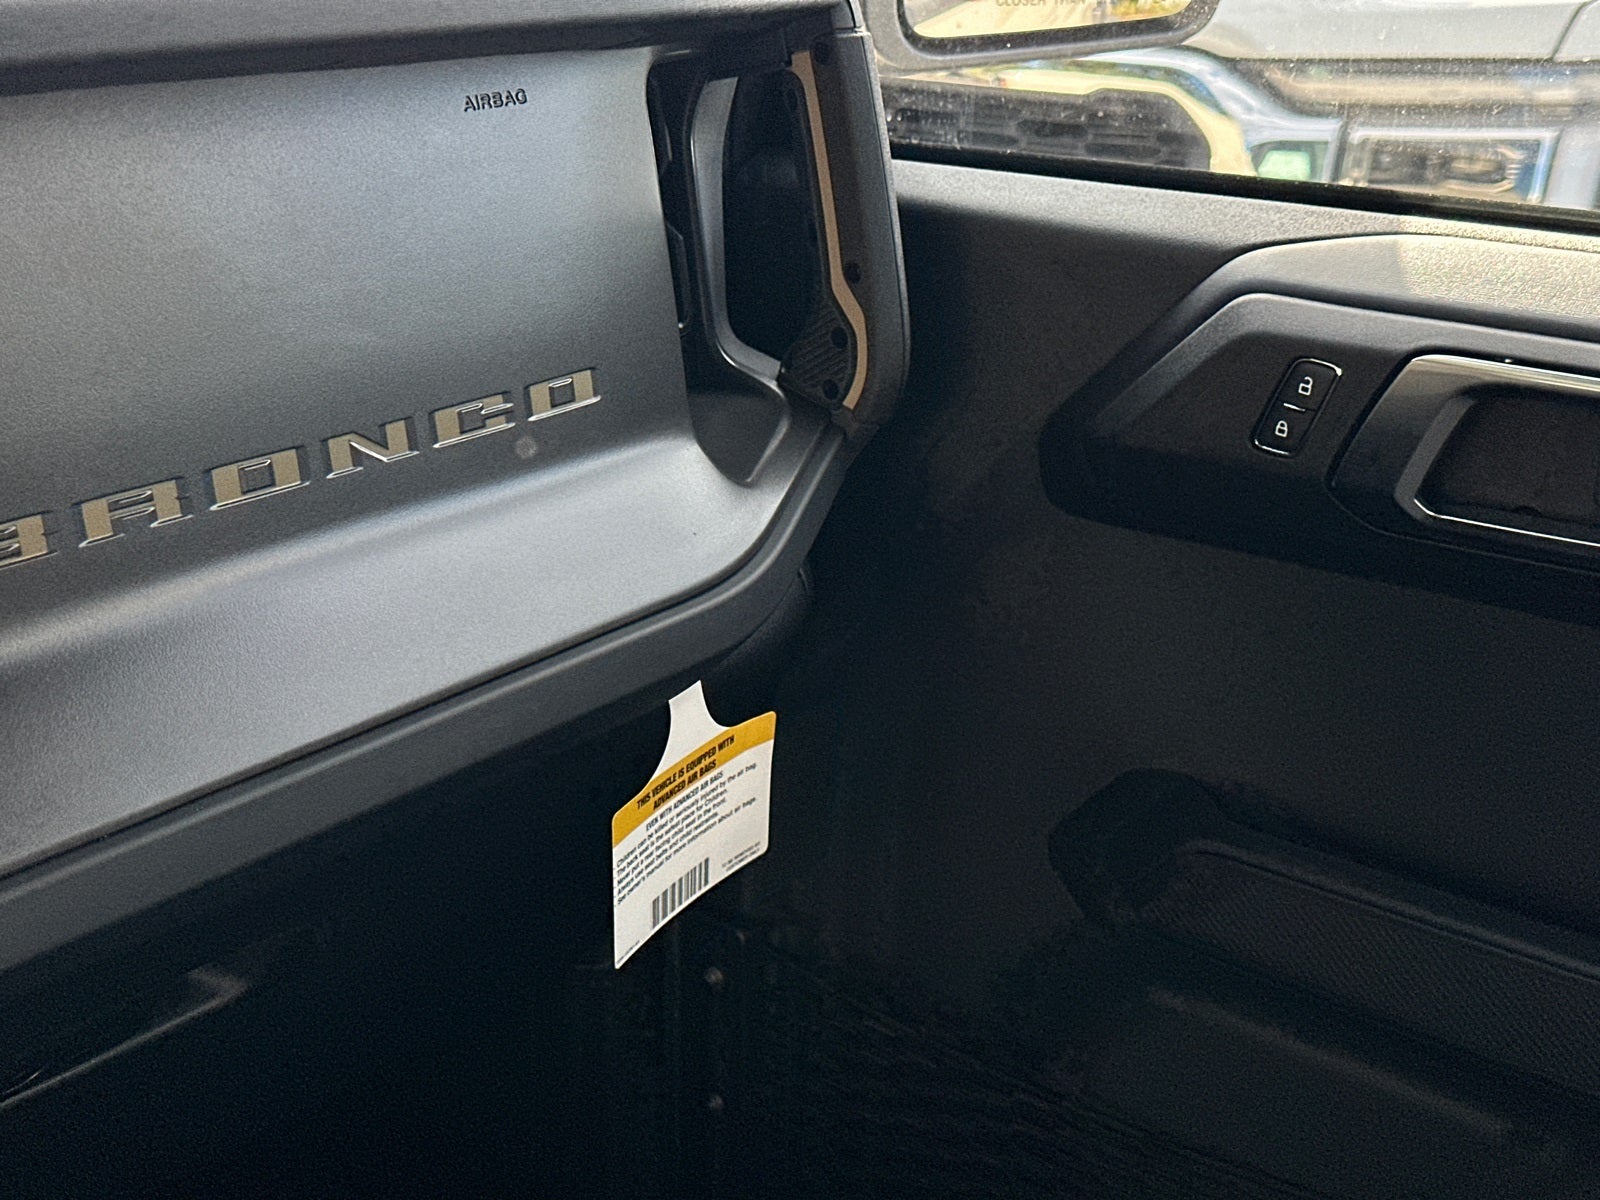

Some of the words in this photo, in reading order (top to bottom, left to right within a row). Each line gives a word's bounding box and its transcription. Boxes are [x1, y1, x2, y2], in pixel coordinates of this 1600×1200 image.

[463, 88, 528, 112] AIRBAG
[637, 790, 650, 810] THIS
[652, 771, 677, 798] VEHICLE
[678, 766, 684, 778] IS
[686, 745, 716, 773] EQUIPPED
[717, 734, 734, 752] WITH
[653, 778, 685, 810] ADVANCED
[687, 770, 697, 785] AIR
[699, 757, 716, 777] BAGS
